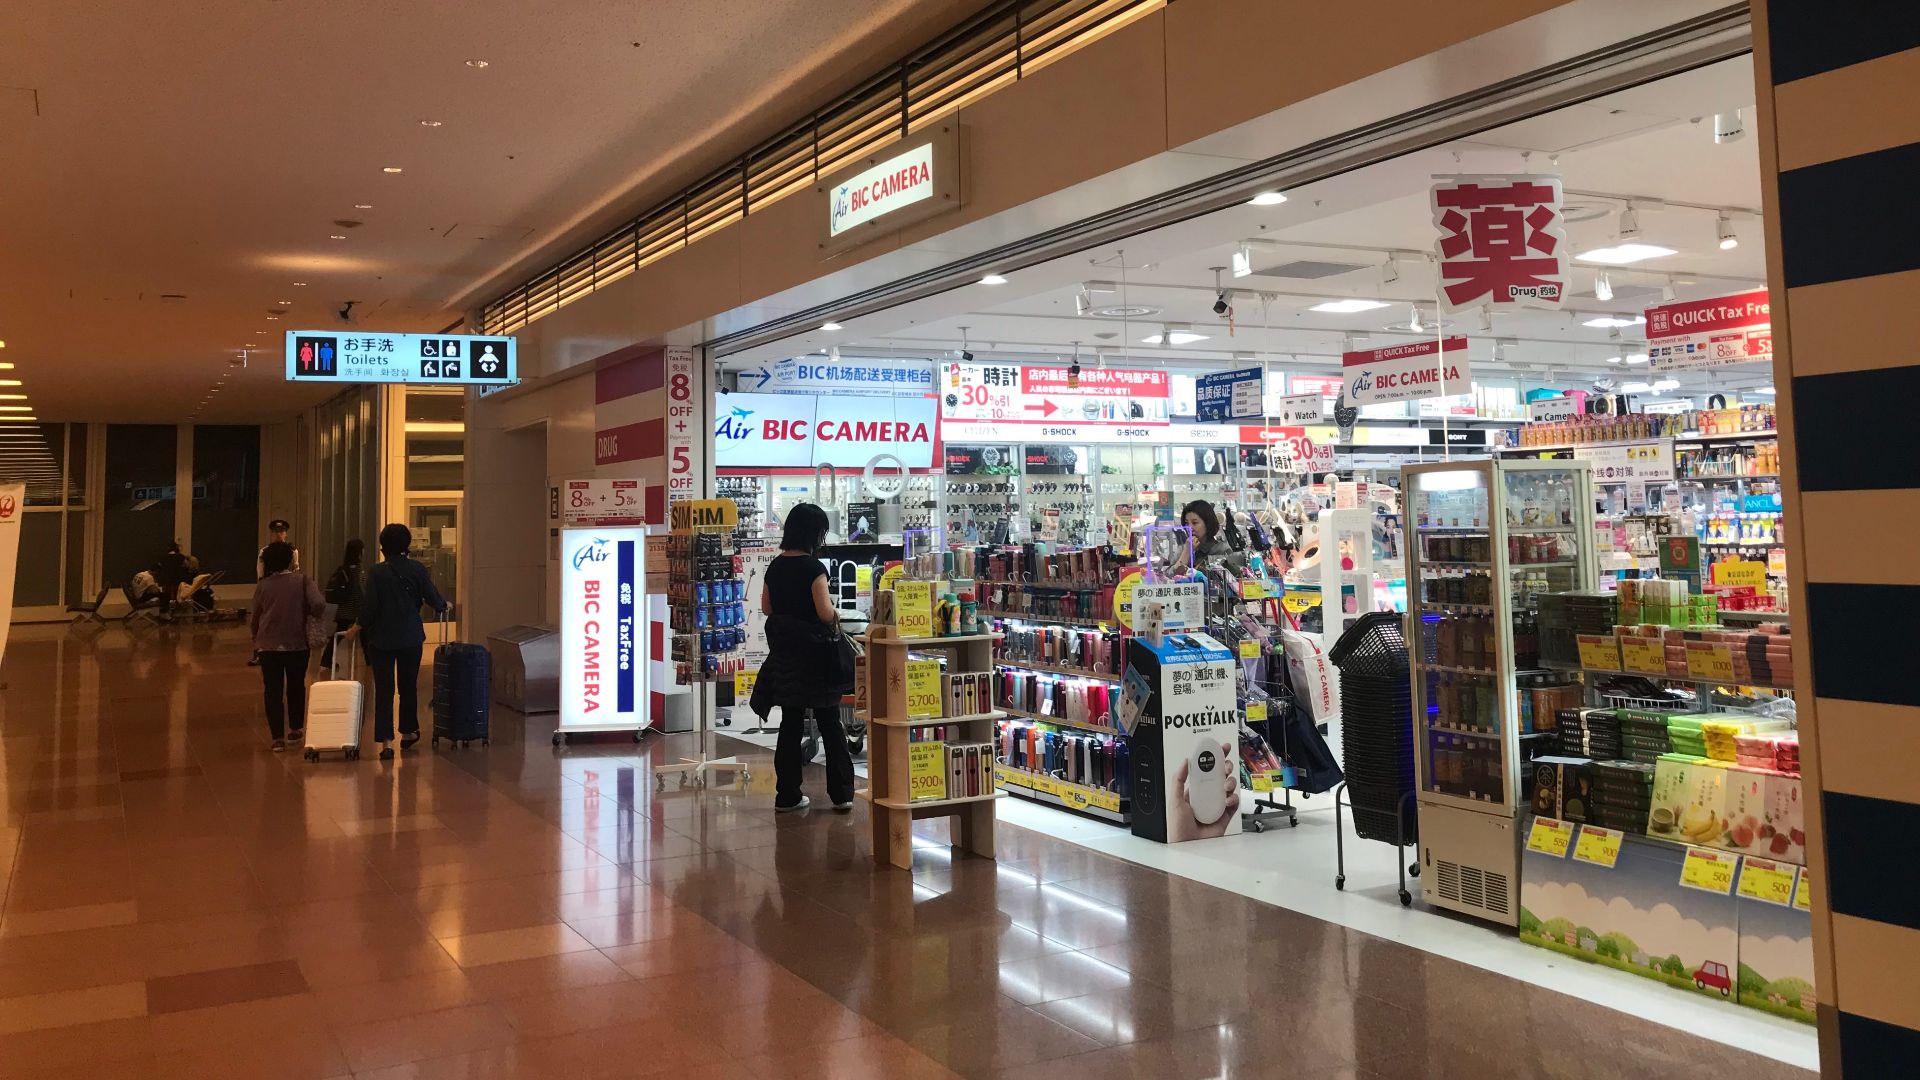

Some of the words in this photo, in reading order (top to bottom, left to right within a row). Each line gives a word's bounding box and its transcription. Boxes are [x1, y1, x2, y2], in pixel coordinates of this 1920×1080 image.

[851, 186, 869, 212] BIC
[871, 161, 930, 202] CAMERA
[1436, 181, 1564, 306] 薬
[1510, 286, 1537, 298] Drug
[1539, 286, 1558, 297] 药妆
[1672, 308, 1717, 327] QUICK
[1717, 306, 1744, 320] Tax
[1746, 302, 1770, 316] Fre
[344, 338, 394, 352] お手洗
[1650, 337, 1676, 346] Payment
[1676, 335, 1691, 343] with
[1383, 347, 1404, 357] QUICK
[1404, 346, 1416, 354] Tax
[1415, 344, 1430, 352] Free
[344, 354, 389, 365] Toilets
[344, 368, 373, 377] 洗手间
[380, 368, 409, 377] 화장실
[983, 366, 1019, 387] 時計
[1376, 373, 1397, 389] BIC
[1400, 365, 1460, 386] CAMERA
[669, 406, 693, 417] OFF
[1294, 410, 1317, 420] Watch
[715, 416, 755, 440] Air
[763, 419, 808, 441] BIC
[816, 420, 929, 443] CAMERA
[1042, 428, 1077, 436] G-SHOCK
[1117, 429, 1150, 437] G-SHOCK
[1190, 429, 1219, 438] SEIKO
[597, 435, 618, 458] DRUG
[1273, 454, 1292, 470] 時計
[669, 478, 693, 489] OFF
[1744, 499, 1770, 508] ANCL
[671, 506, 691, 530] SIM
[574, 544, 612, 570] Air
[584, 580, 600, 614] BIC
[620, 616, 632, 670] TaxFree
[1604, 652, 1618, 662] 550
[1650, 656, 1665, 665] 600
[584, 620, 600, 714] CAMERA
[1316, 658, 1325, 673] BIC
[1711, 660, 1732, 671] 1000
[1172, 682, 1196, 696] 登場。
[1320, 674, 1331, 713] CAMERA
[1164, 709, 1236, 730] POCKETALK
[1552, 837, 1568, 848] 550
[1712, 872, 1731, 883] 500
[1772, 883, 1790, 894] 500
